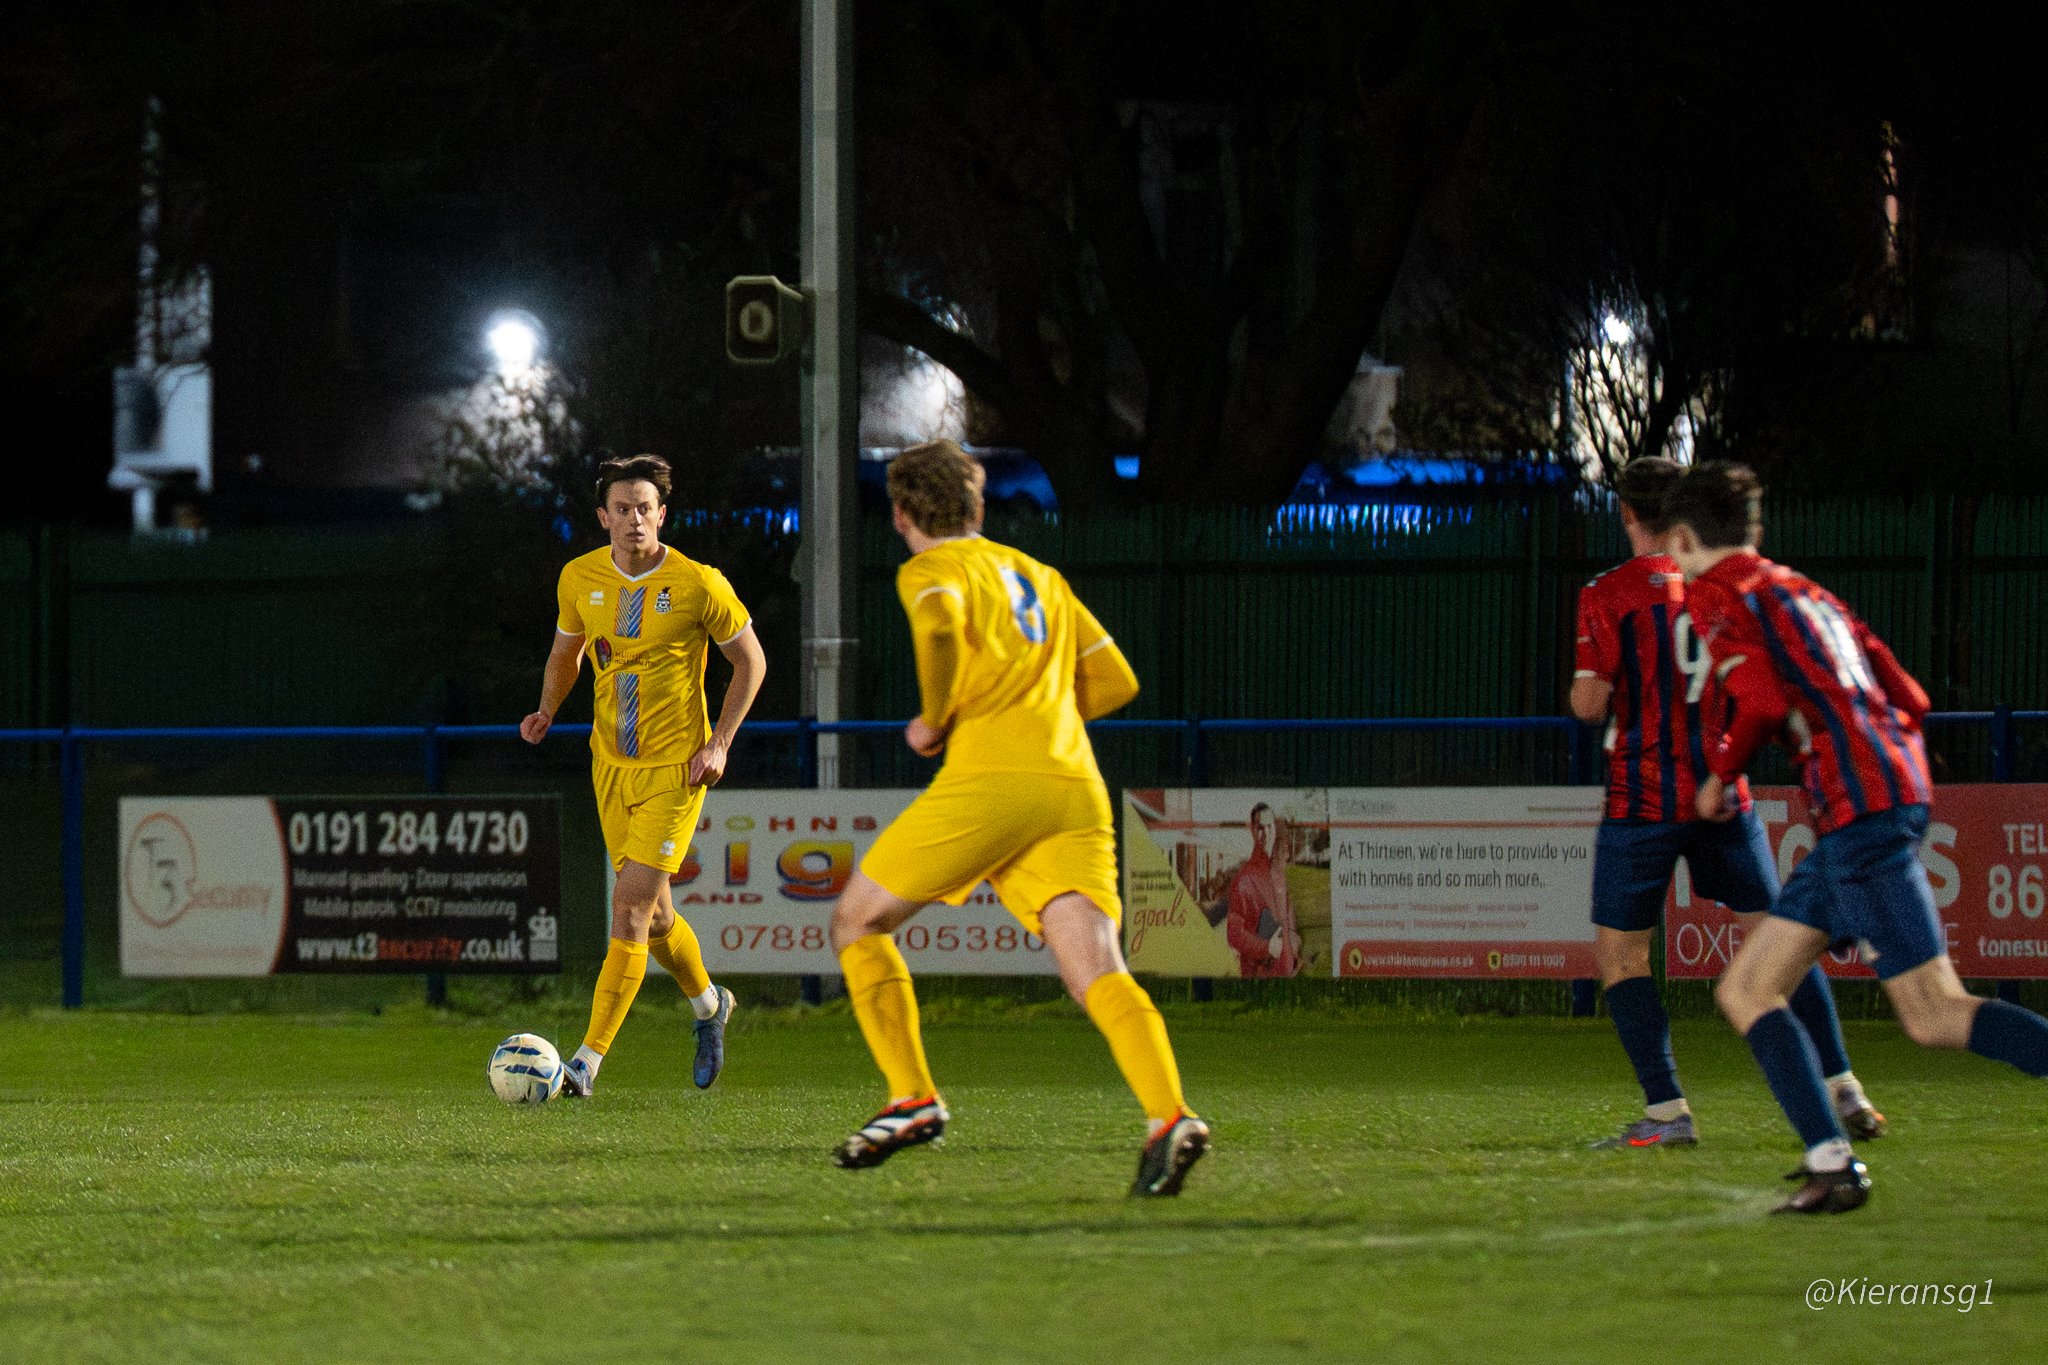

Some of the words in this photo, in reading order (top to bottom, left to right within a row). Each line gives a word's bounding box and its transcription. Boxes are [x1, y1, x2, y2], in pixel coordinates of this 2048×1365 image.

[1674, 612, 1712, 703] 9
[289, 811, 369, 855] 0191
[376, 811, 439, 856] 284
[445, 811, 529, 856] 4730
[1338, 841, 1353, 859] At
[1456, 841, 1487, 860] here
[1489, 842, 1504, 860] to
[1507, 841, 1558, 863] provide
[1561, 845, 1587, 864] you
[1339, 869, 1367, 888] with
[1370, 869, 1414, 889] homes
[1416, 868, 1441, 888] and
[1445, 872, 1461, 888] so
[1464, 868, 1501, 888] much
[679, 892, 763, 904] AND
[720, 924, 825, 951] 0788
[892, 925, 1047, 951] 05380
